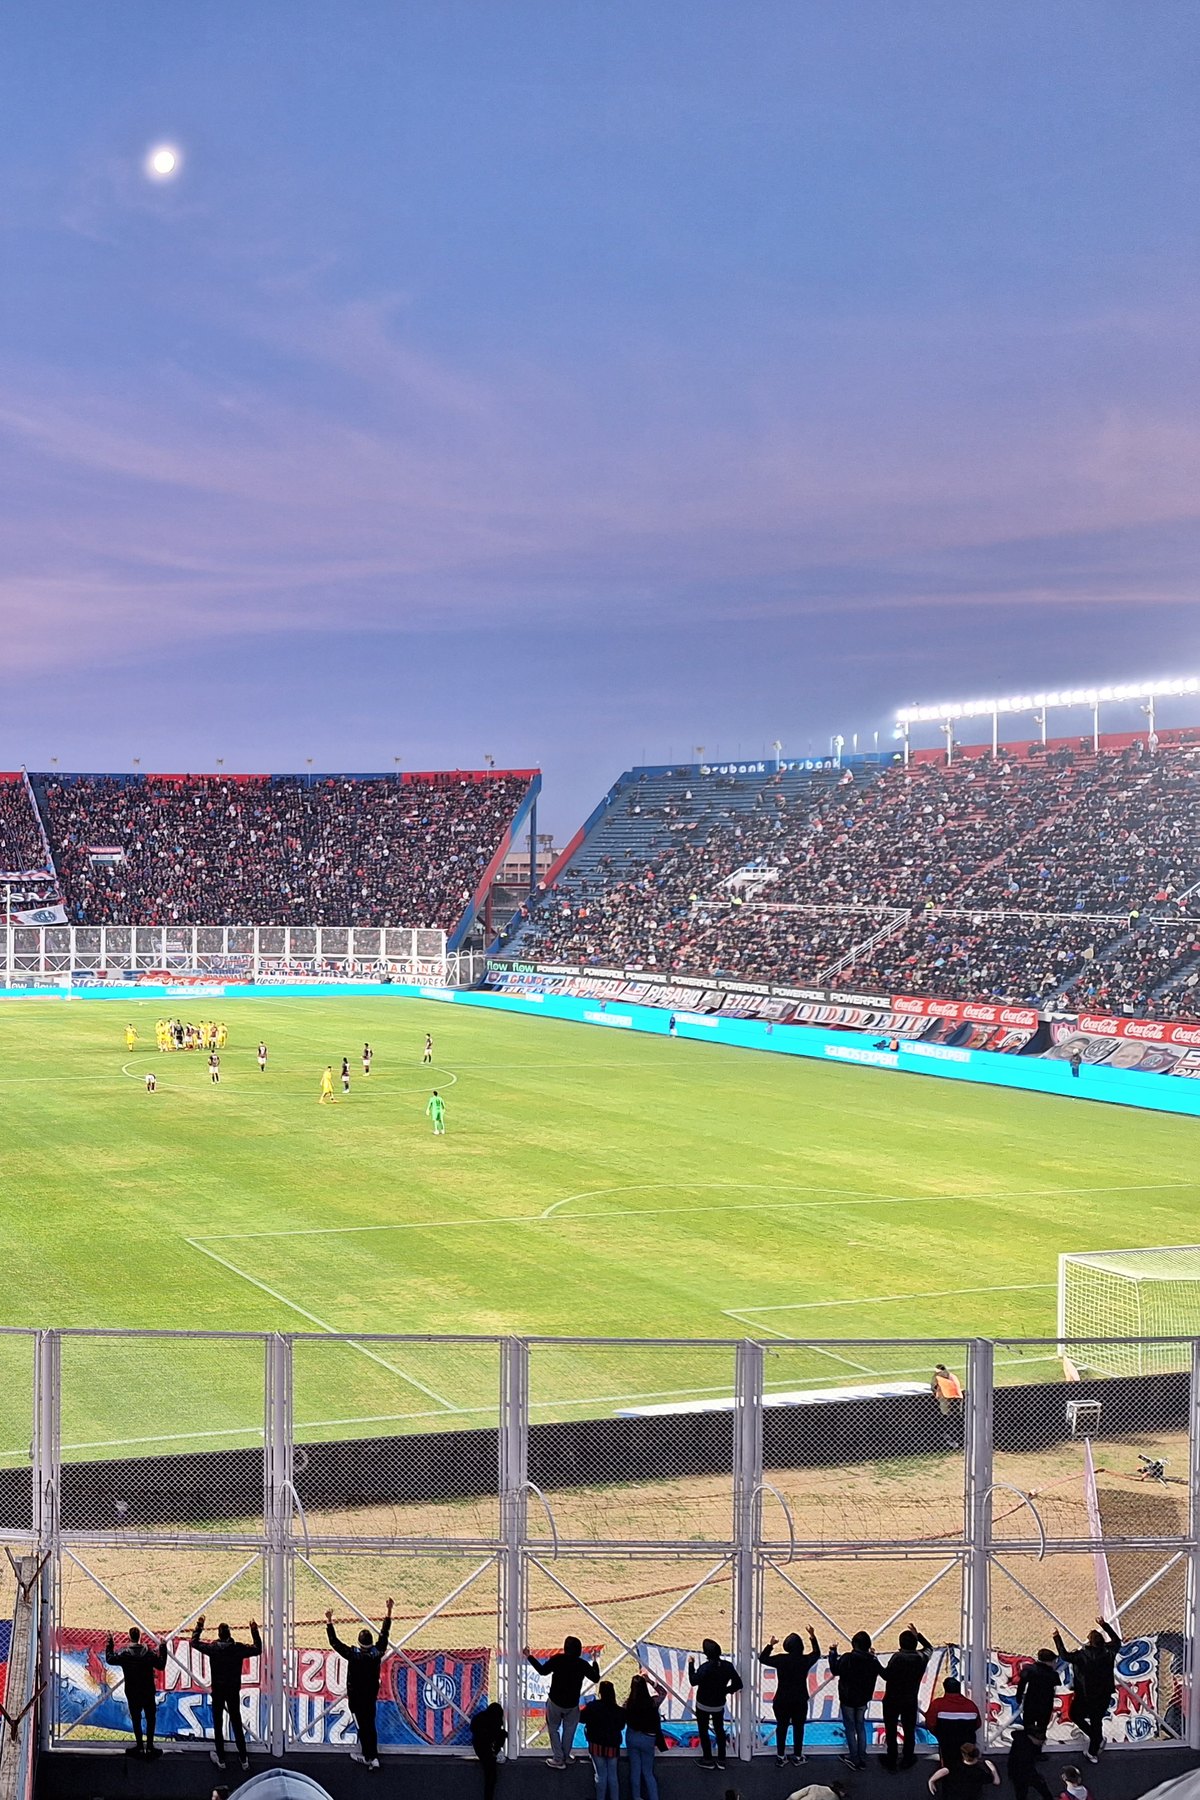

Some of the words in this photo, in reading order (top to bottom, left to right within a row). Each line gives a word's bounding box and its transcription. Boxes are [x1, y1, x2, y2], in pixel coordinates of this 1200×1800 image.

[276, 961, 310, 969] TALAR
[378, 962, 443, 975] MARTINEZ
[411, 977, 445, 987] ANDRES
[487, 960, 508, 971] flow
[512, 962, 535, 973] flow
[670, 975, 718, 989] POWERADE
[718, 981, 771, 995] POWERADE
[772, 987, 826, 1001] POWERADE
[830, 993, 892, 1008] POWERADE
[647, 985, 703, 1004] ROSARIO
[797, 1005, 861, 1021] CIUDAD
[874, 1015, 932, 1031] EVITA
[894, 999, 924, 1013] Coca-Cola
[928, 1002, 960, 1017] Coca-Cola
[963, 1005, 996, 1021] Coca-Cola
[1000, 1009, 1035, 1025] Coca-Cola
[1081, 1017, 1119, 1034] Coca-Cola
[1124, 1022, 1165, 1039] Coca-Cola
